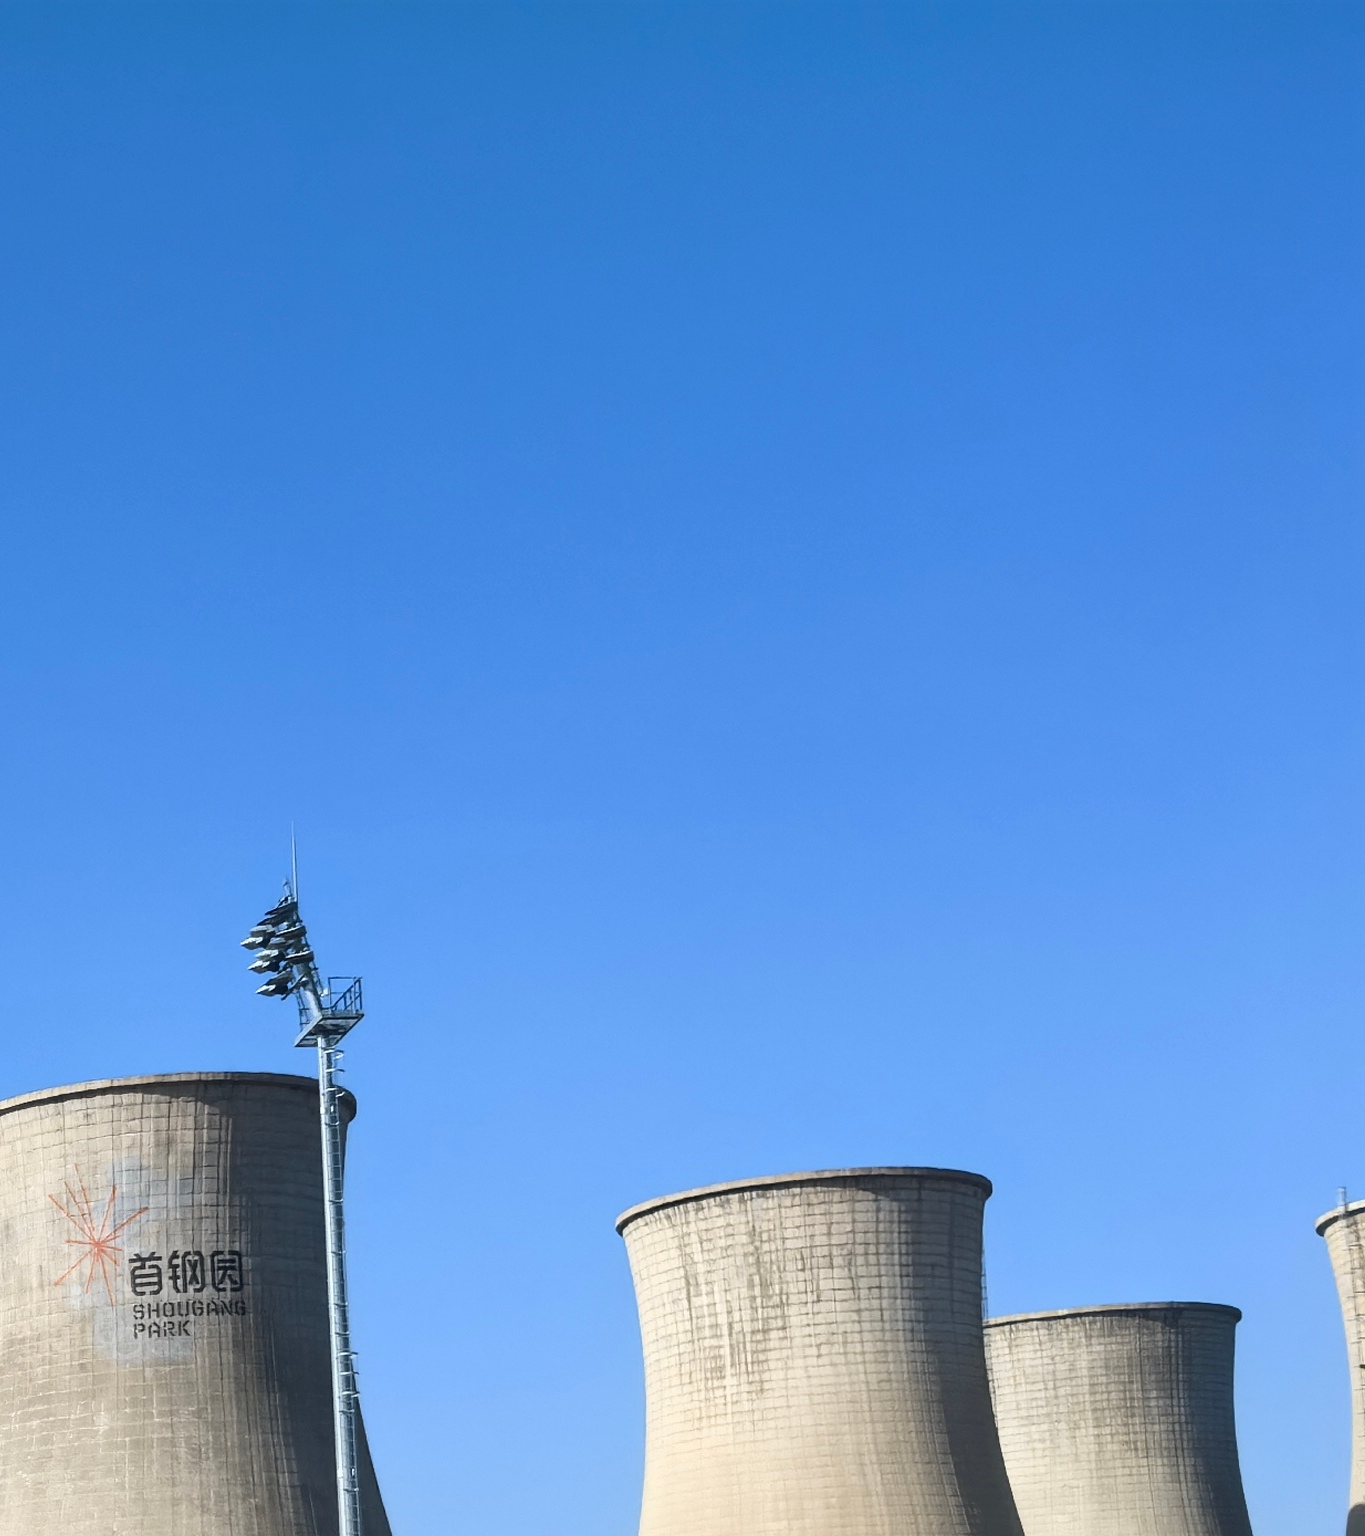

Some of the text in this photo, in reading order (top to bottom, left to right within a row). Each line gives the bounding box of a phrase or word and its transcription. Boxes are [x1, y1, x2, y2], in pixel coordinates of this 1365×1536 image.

[129, 1250, 244, 1296] 首钢园
[132, 1300, 247, 1320] SHOUGANG
[132, 1320, 191, 1339] PARK
